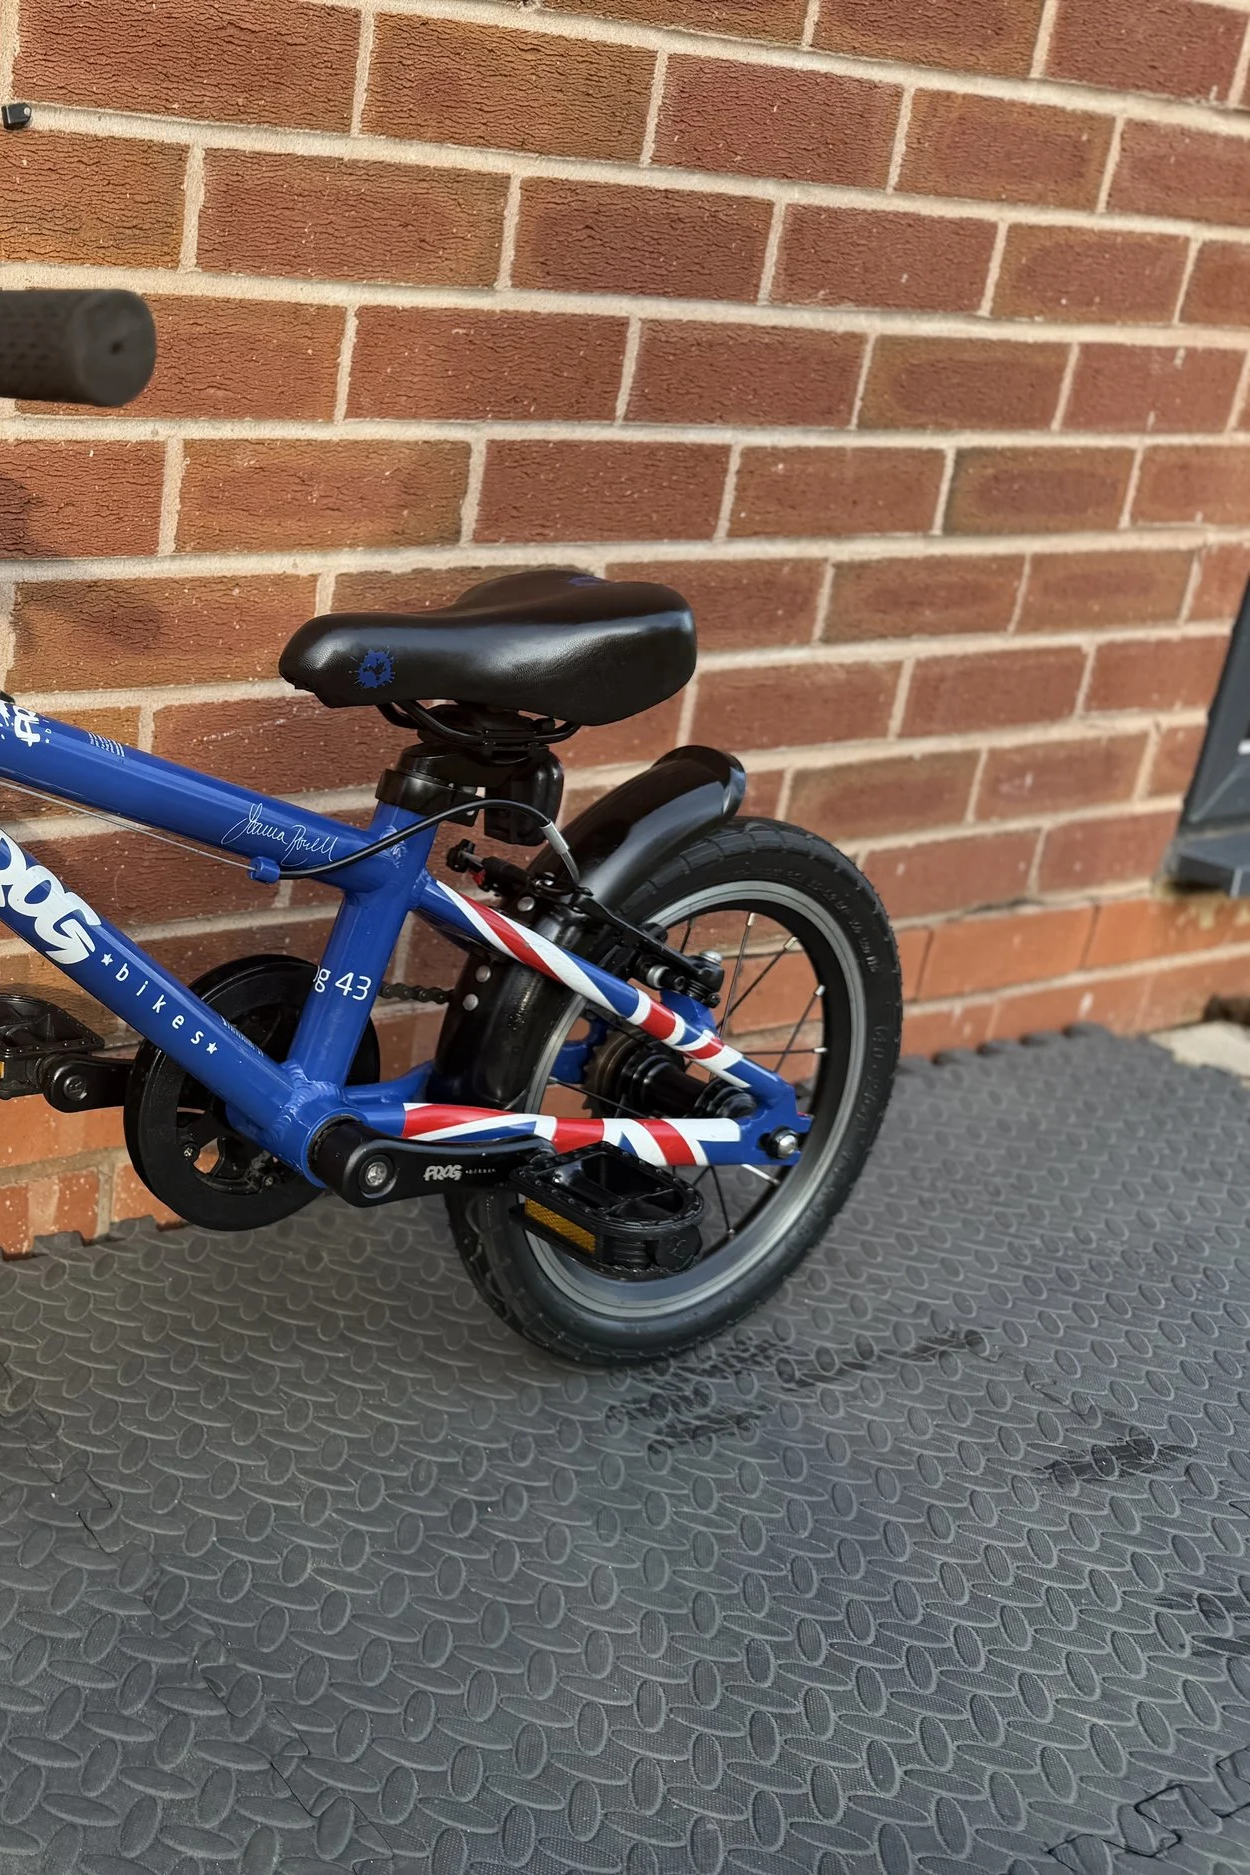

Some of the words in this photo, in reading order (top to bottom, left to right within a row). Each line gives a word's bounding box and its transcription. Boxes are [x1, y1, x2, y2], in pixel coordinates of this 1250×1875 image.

[335, 972, 371, 1001] 43
[115, 963, 204, 1045] bikes
[423, 1164, 463, 1181] FROG
